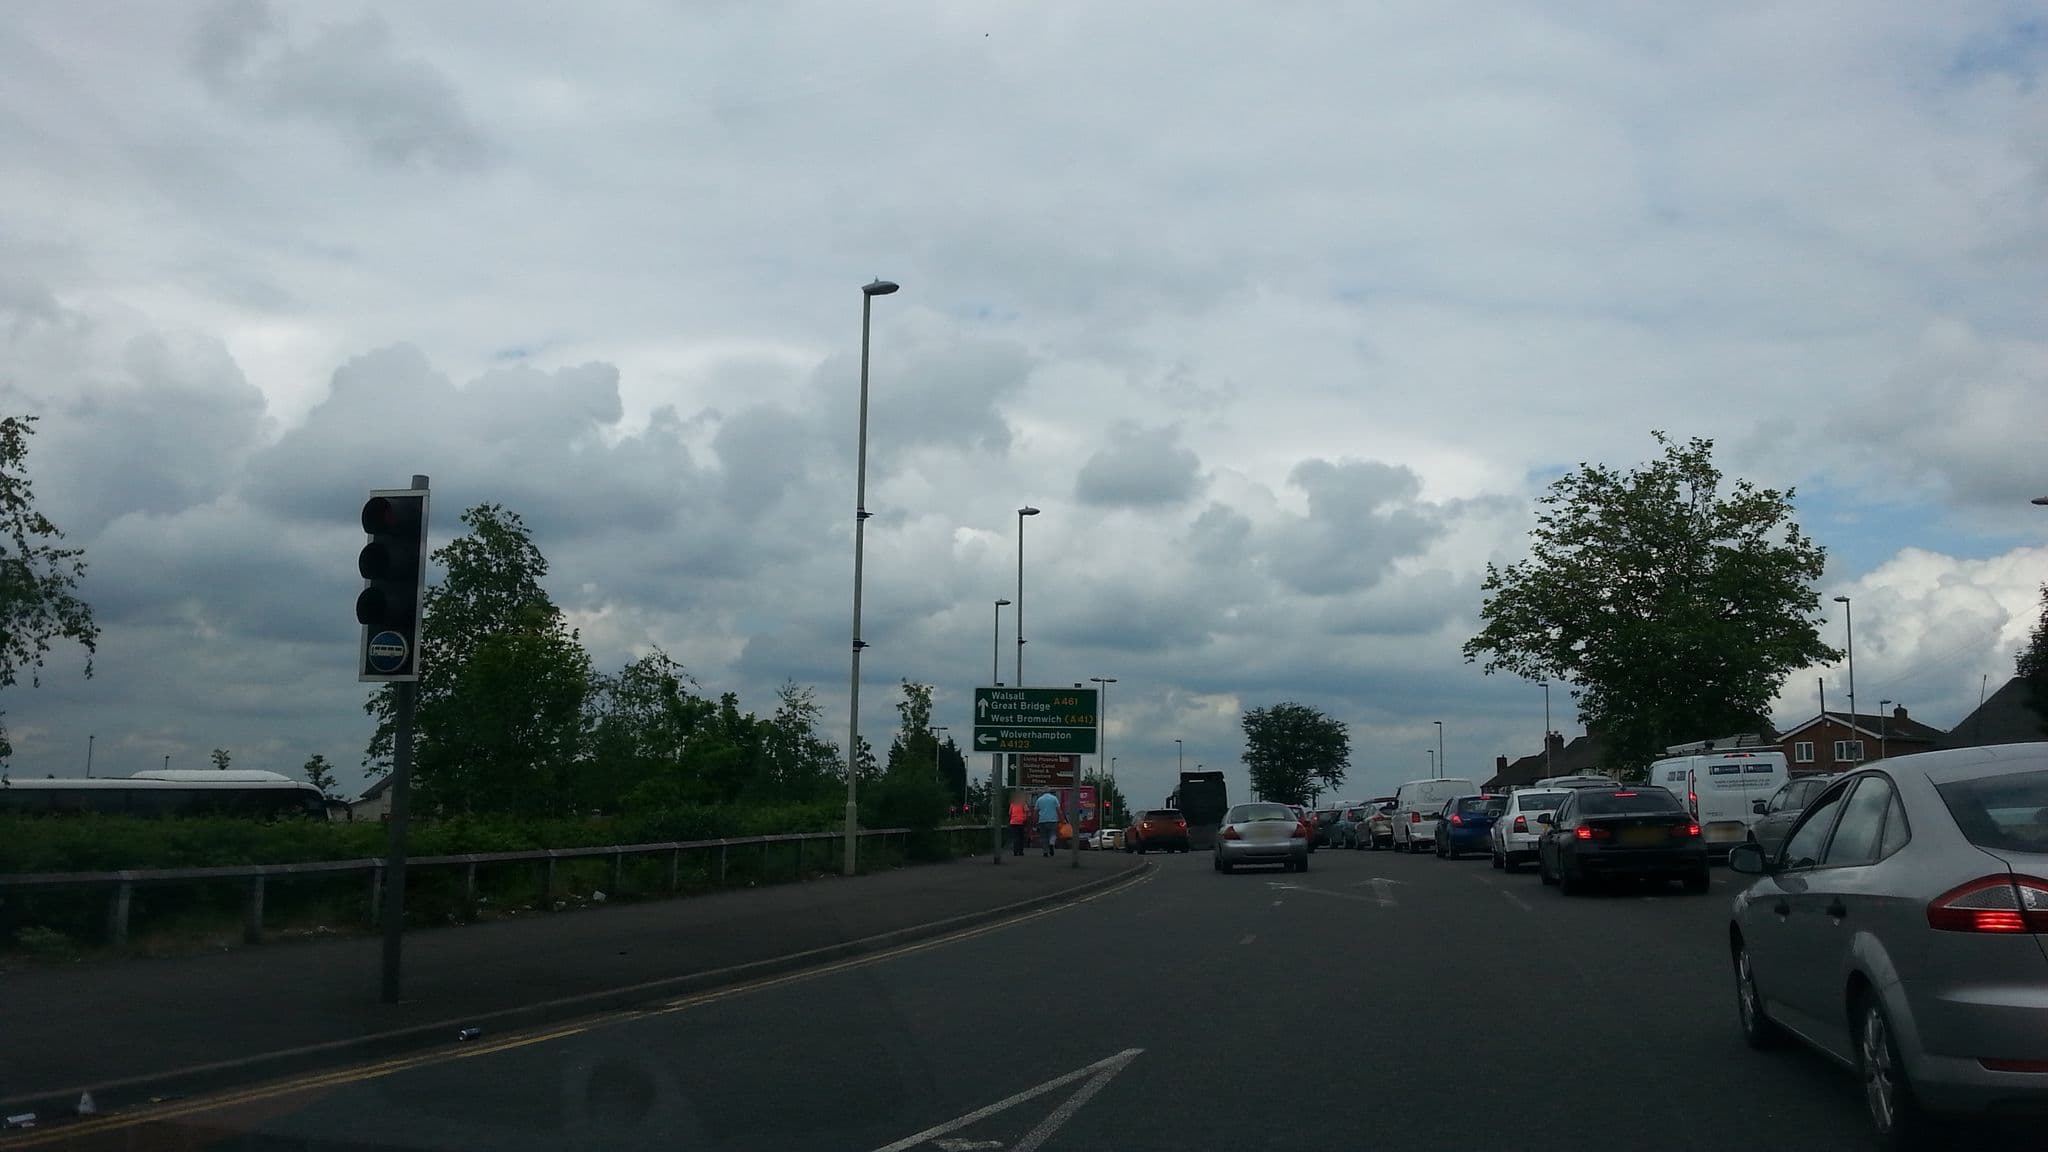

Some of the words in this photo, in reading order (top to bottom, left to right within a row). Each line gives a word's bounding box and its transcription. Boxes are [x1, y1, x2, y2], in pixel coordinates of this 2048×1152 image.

[991, 691, 1025, 700] Walsall
[1053, 697, 1078, 706] A461
[990, 701, 1017, 710] Great
[1020, 702, 1051, 712] Bridge
[990, 714, 1014, 723] West
[1016, 714, 1062, 723] Bromwich
[1064, 715, 1094, 725] (A41)
[1000, 730, 1072, 740] Wolverhampton
[1000, 740, 1030, 749] A4123
